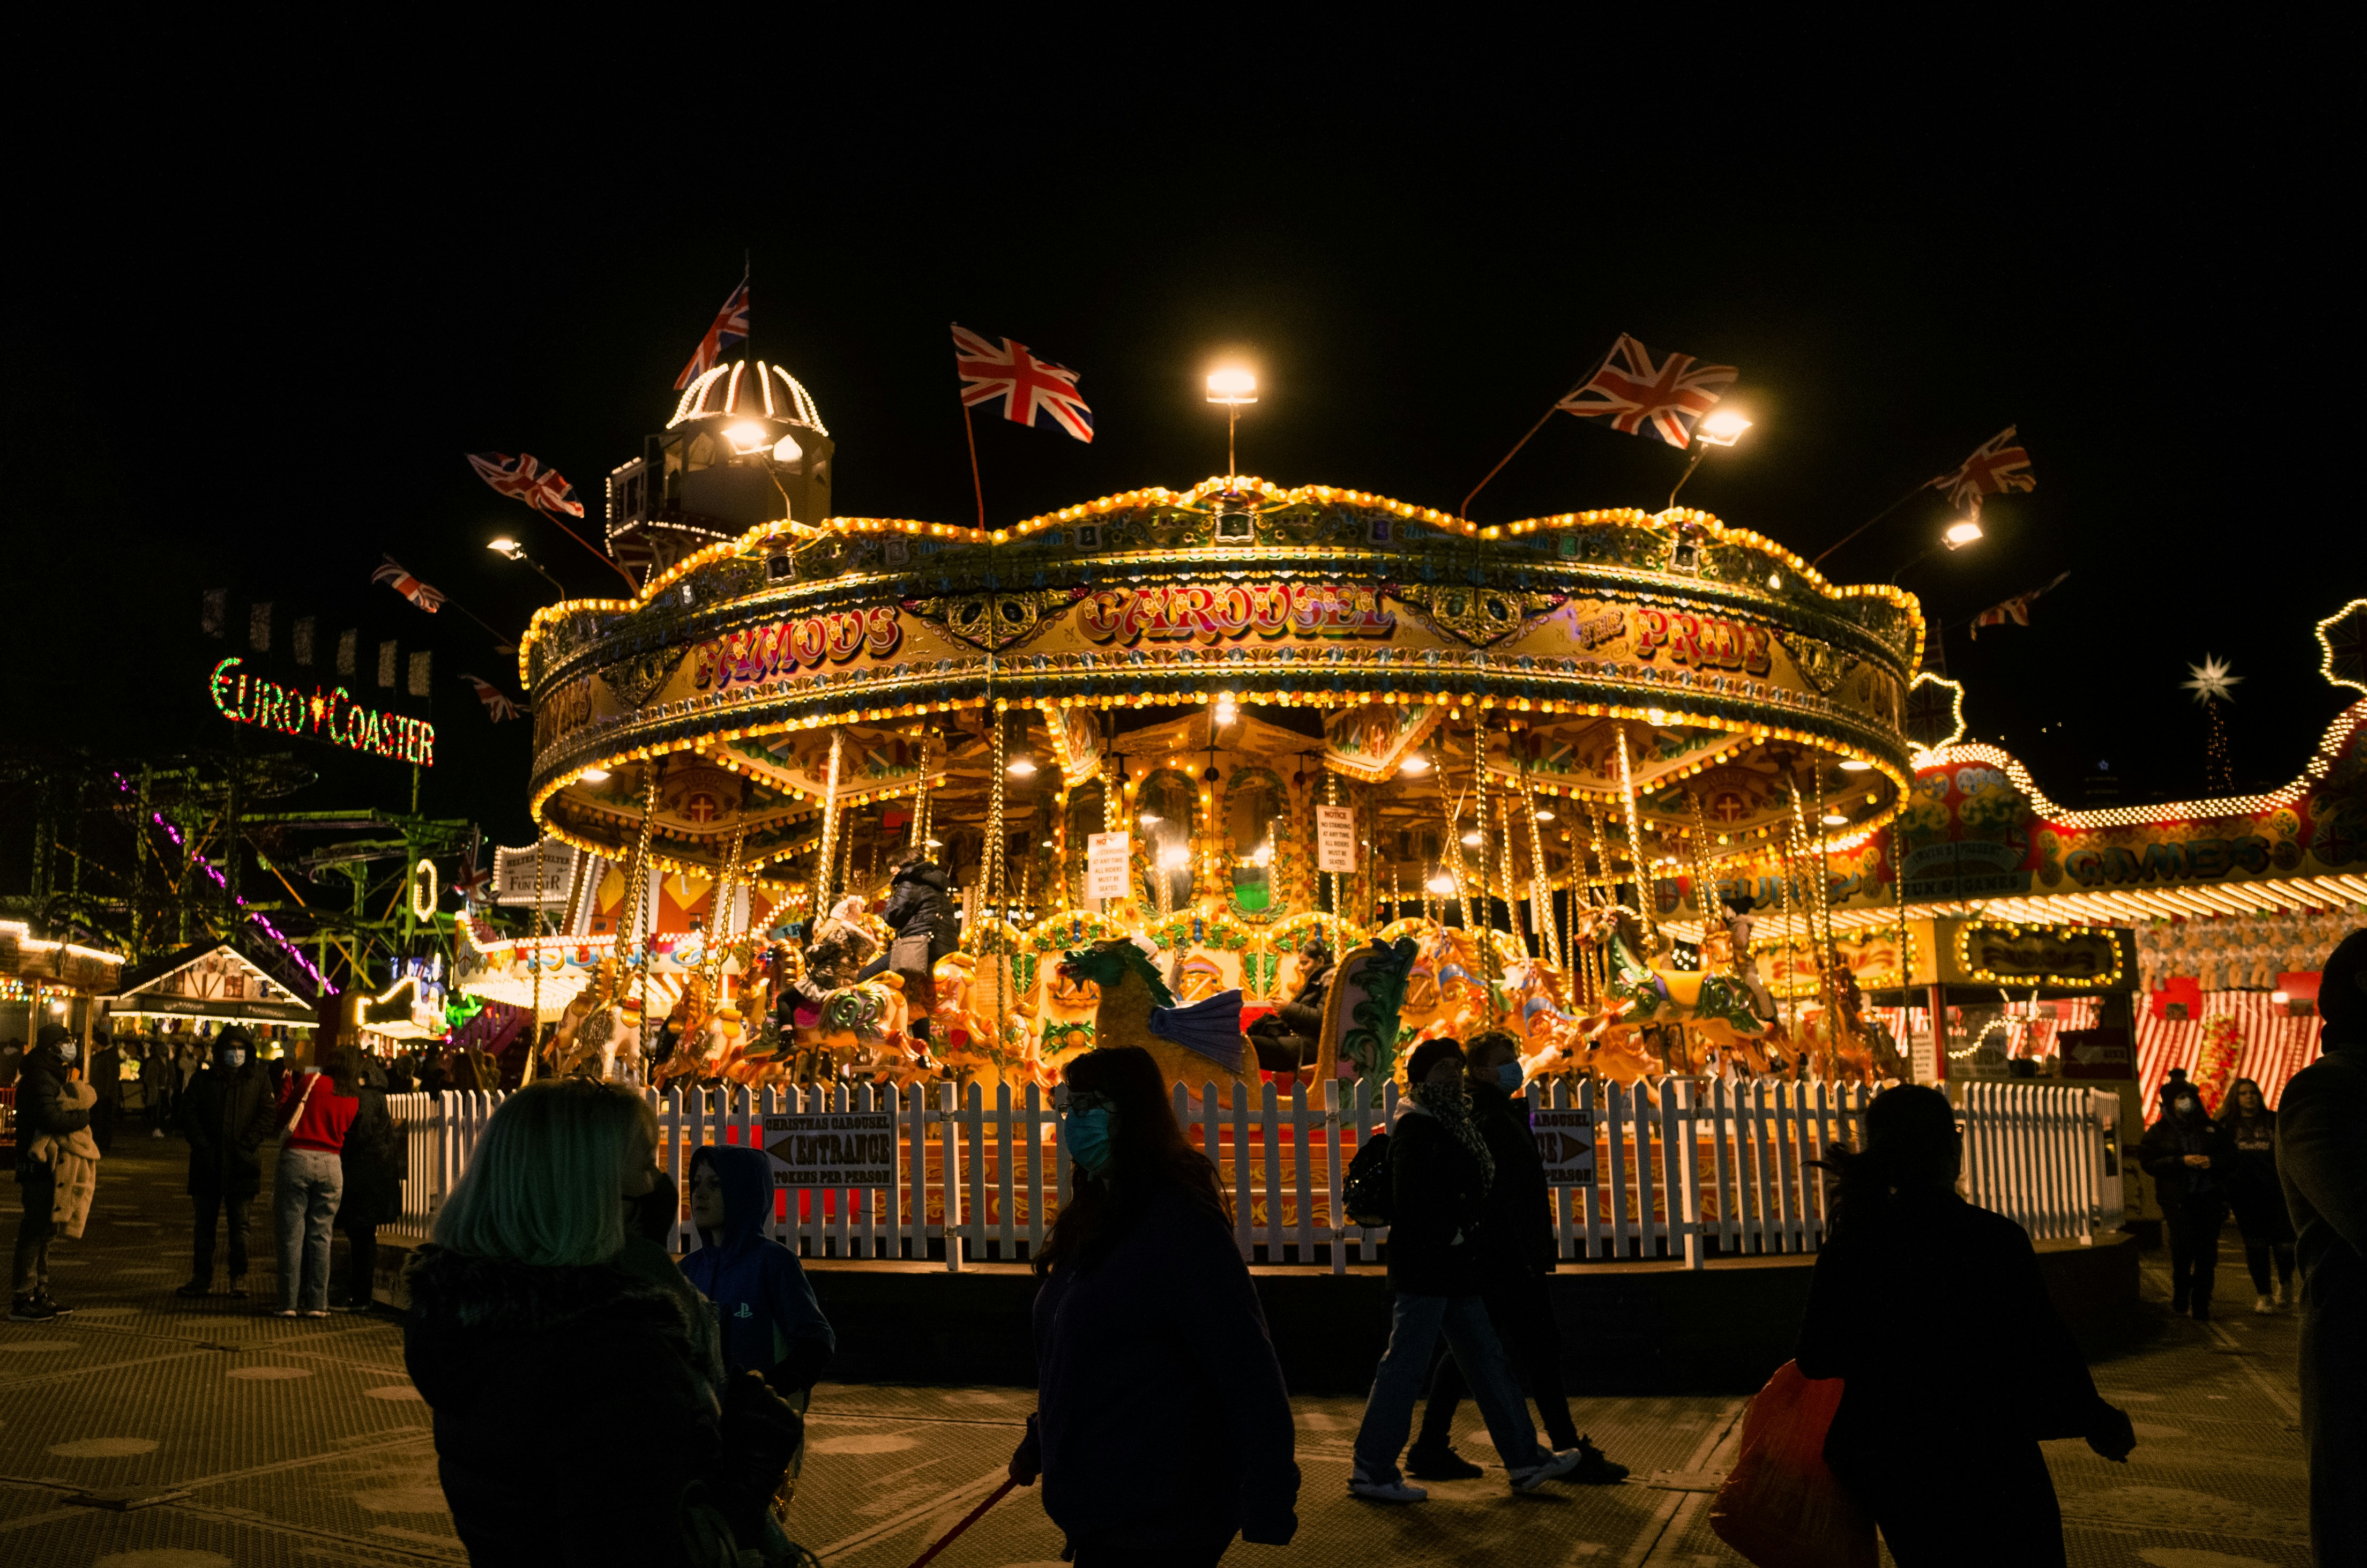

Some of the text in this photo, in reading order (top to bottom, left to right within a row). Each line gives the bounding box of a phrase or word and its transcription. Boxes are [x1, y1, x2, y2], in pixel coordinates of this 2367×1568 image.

[1079, 585, 1397, 645] CAROUSEL
[695, 605, 901, 689] FAMOUS
[1634, 608, 1772, 672] PRIDE
[210, 658, 435, 767] EURO COASTER
[1324, 811, 1347, 819] NOTICE
[1100, 848, 1125, 856] STANDING
[507, 855, 535, 867] HELTER
[2065, 835, 2270, 886] GAMES
[510, 876, 530, 890] FUN
[765, 1116, 890, 1131] CHRISTMAS CAROUSEL
[1534, 1114, 1590, 1127] AROUSEL
[795, 1133, 890, 1165] ENTRANCE
[774, 1170, 890, 1184] TOKENS PER PERSON
